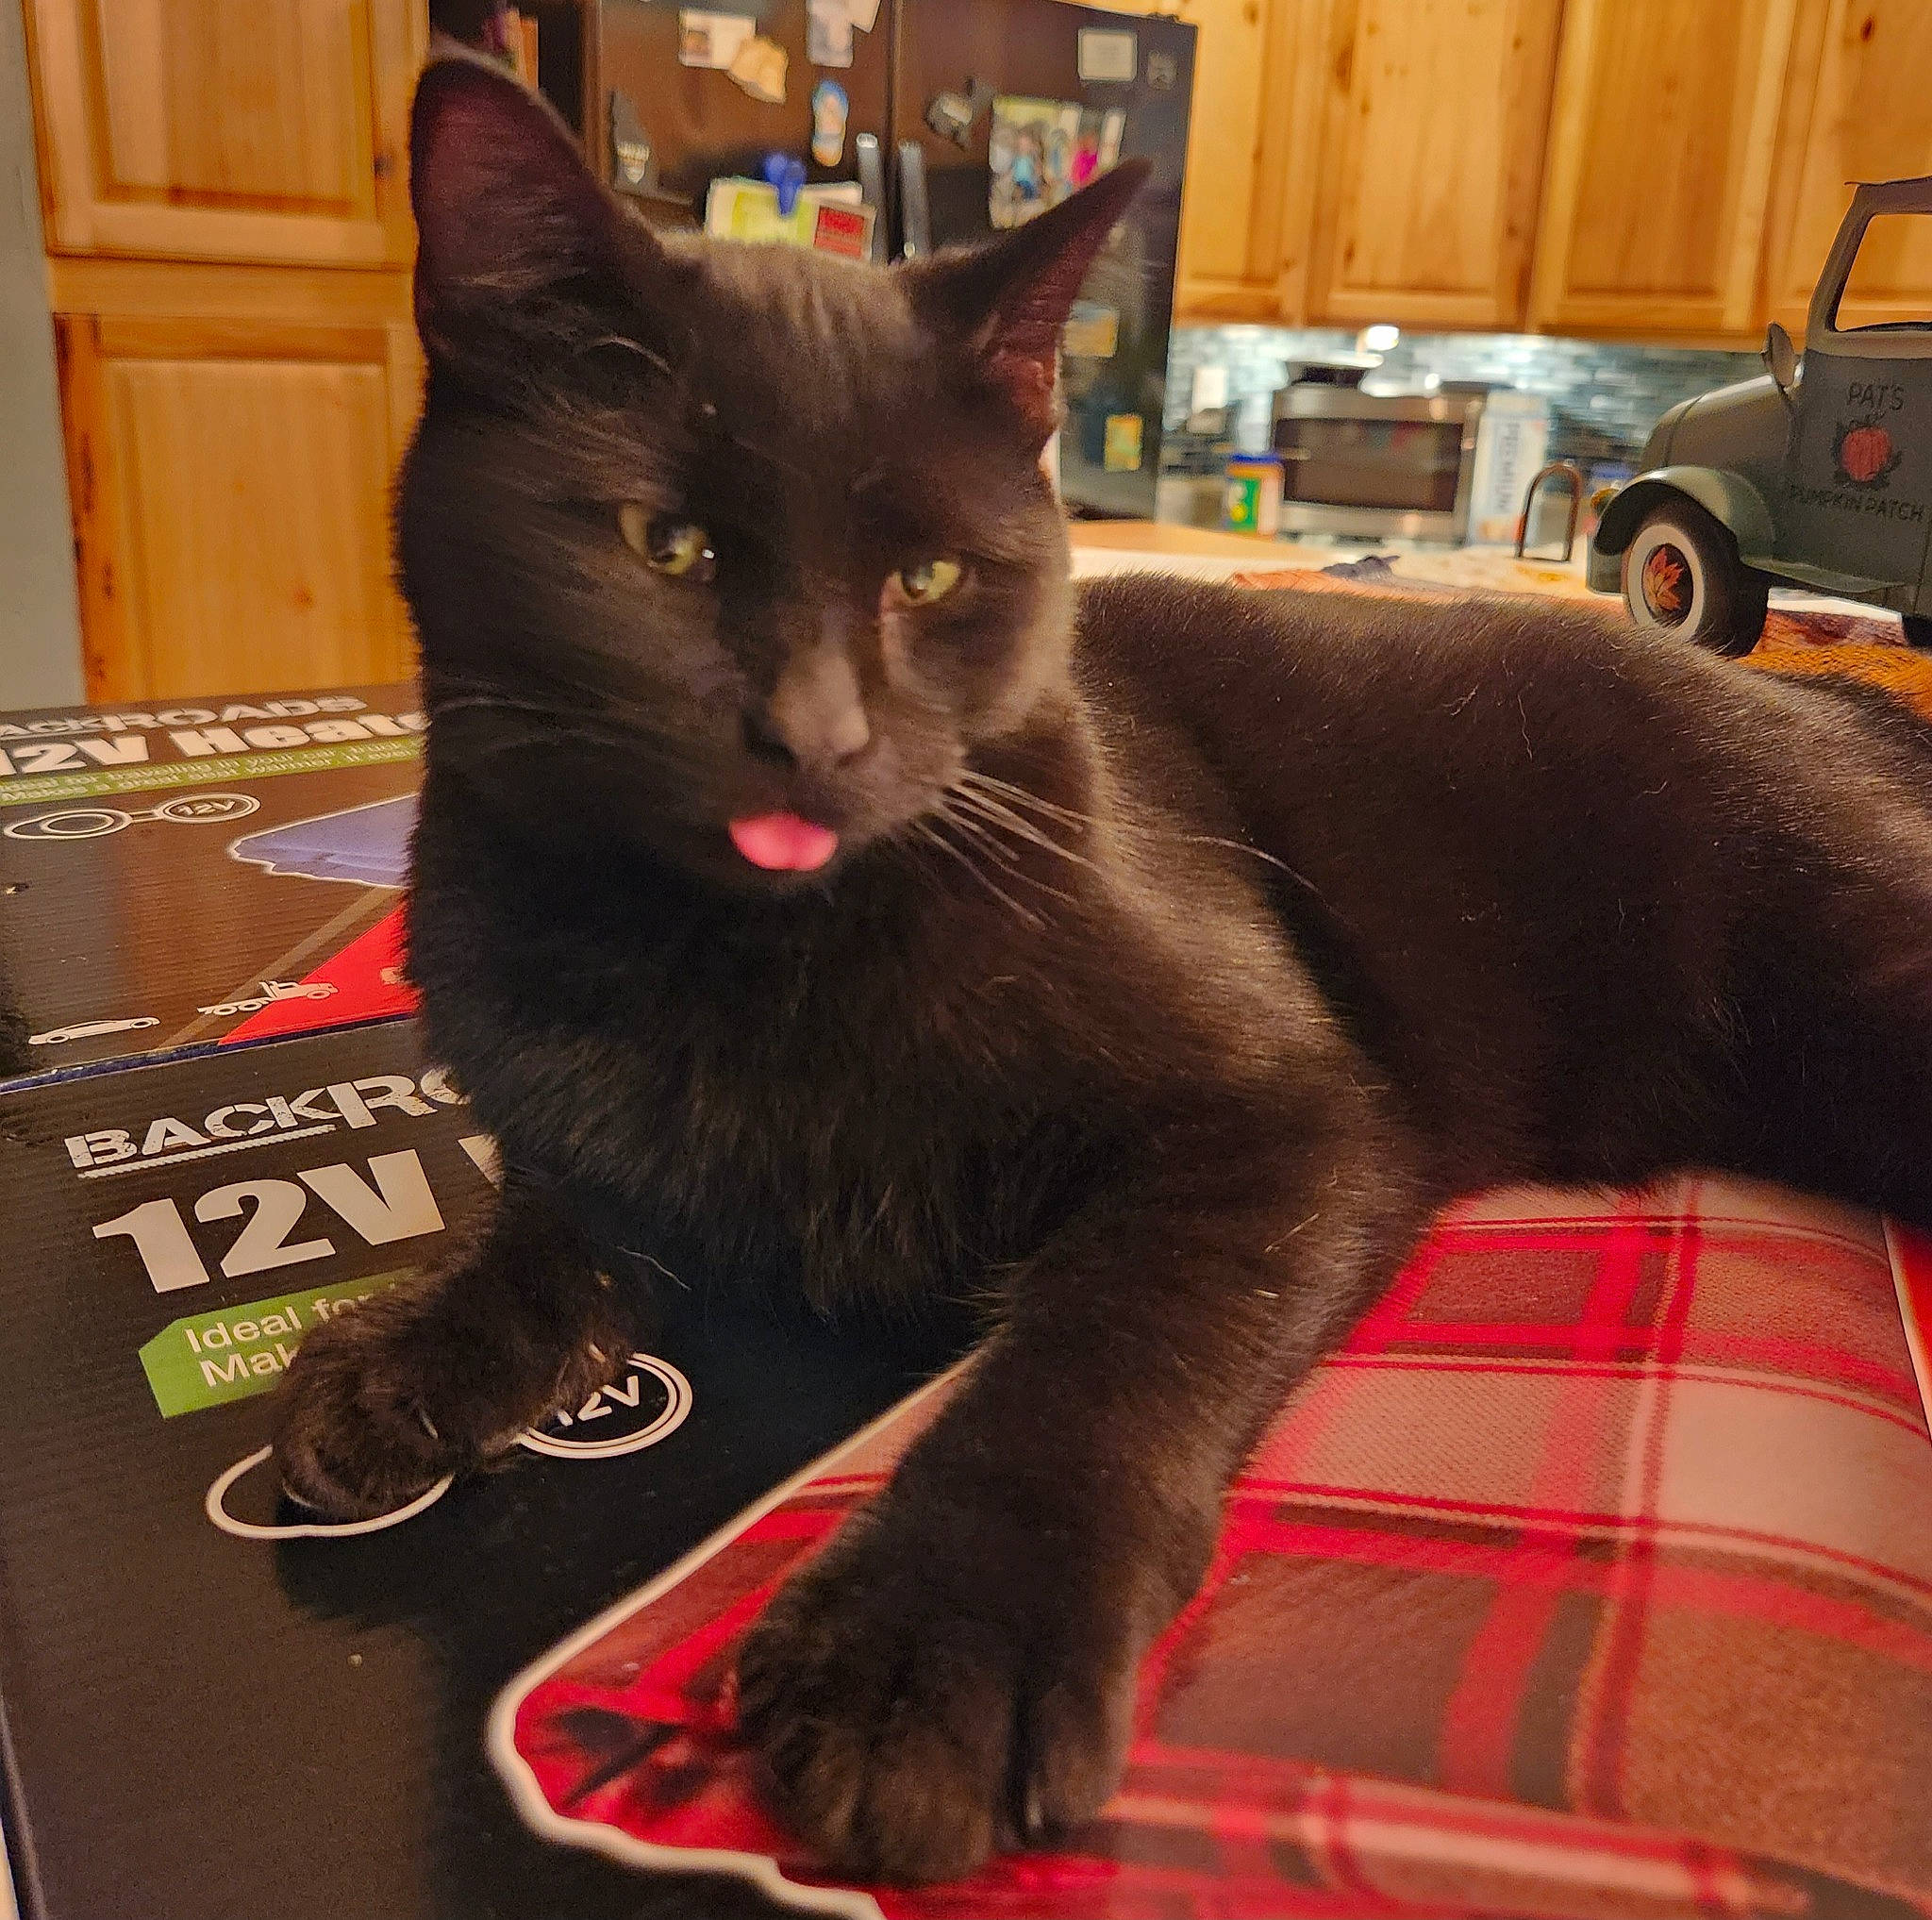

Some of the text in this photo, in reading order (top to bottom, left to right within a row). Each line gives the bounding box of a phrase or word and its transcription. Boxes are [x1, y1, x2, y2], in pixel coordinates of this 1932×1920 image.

[1846, 382, 1905, 410] PAT'S
[1864, 496, 1925, 522] PATCH
[176, 798, 236, 817] 12V
[92, 1148, 447, 1294] 12V
[184, 1293, 375, 1354] Ideal fo
[558, 1374, 640, 1427] 2V
